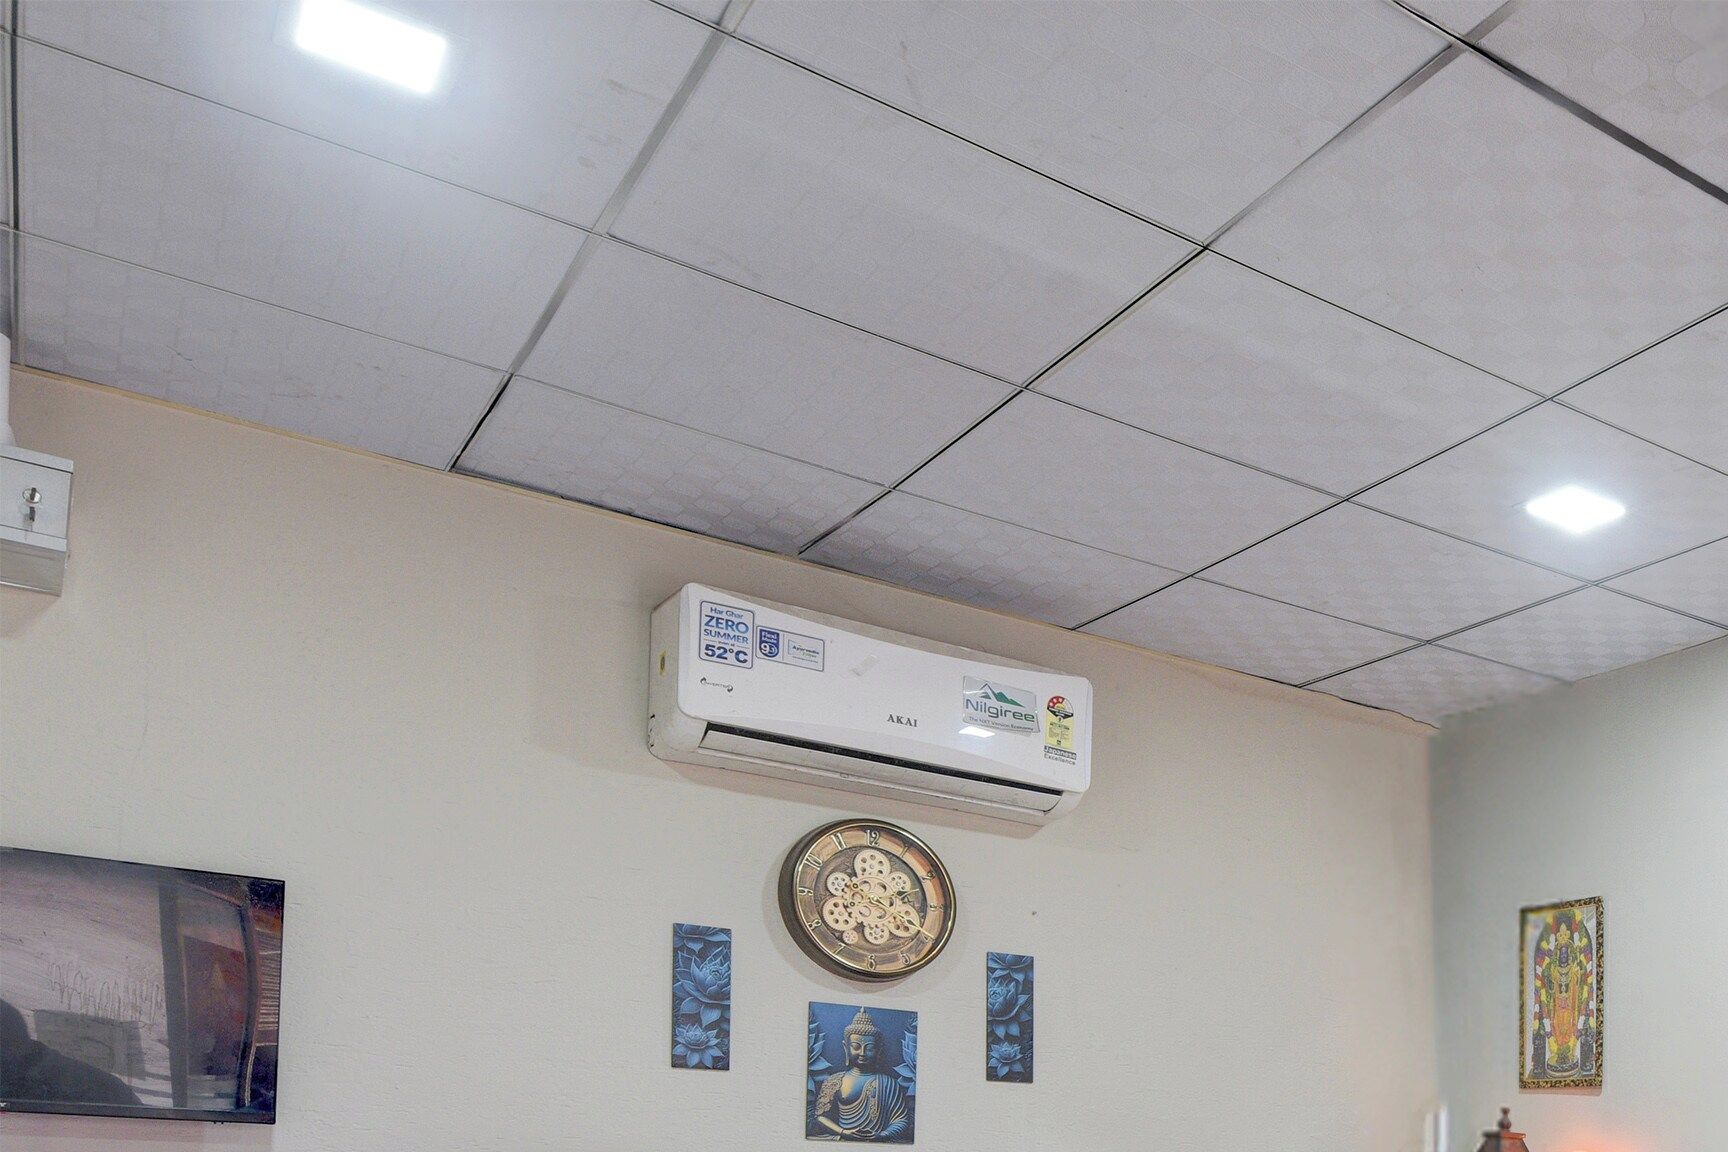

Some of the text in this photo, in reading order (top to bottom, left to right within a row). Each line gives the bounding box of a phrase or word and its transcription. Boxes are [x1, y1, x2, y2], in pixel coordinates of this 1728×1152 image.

[710, 607, 743, 619] Har Ghar
[704, 614, 750, 634] ZERO
[703, 629, 749, 644] SUMMER
[704, 643, 749, 663] 52°C
[965, 698, 1035, 723] Nilgiree
[887, 713, 918, 728] AKAI
[831, 832, 847, 850] 11
[865, 829, 880, 847] 12
[804, 853, 823, 871] 10
[798, 887, 814, 896] 9
[807, 919, 821, 930] 8
[867, 953, 876, 970] 6
